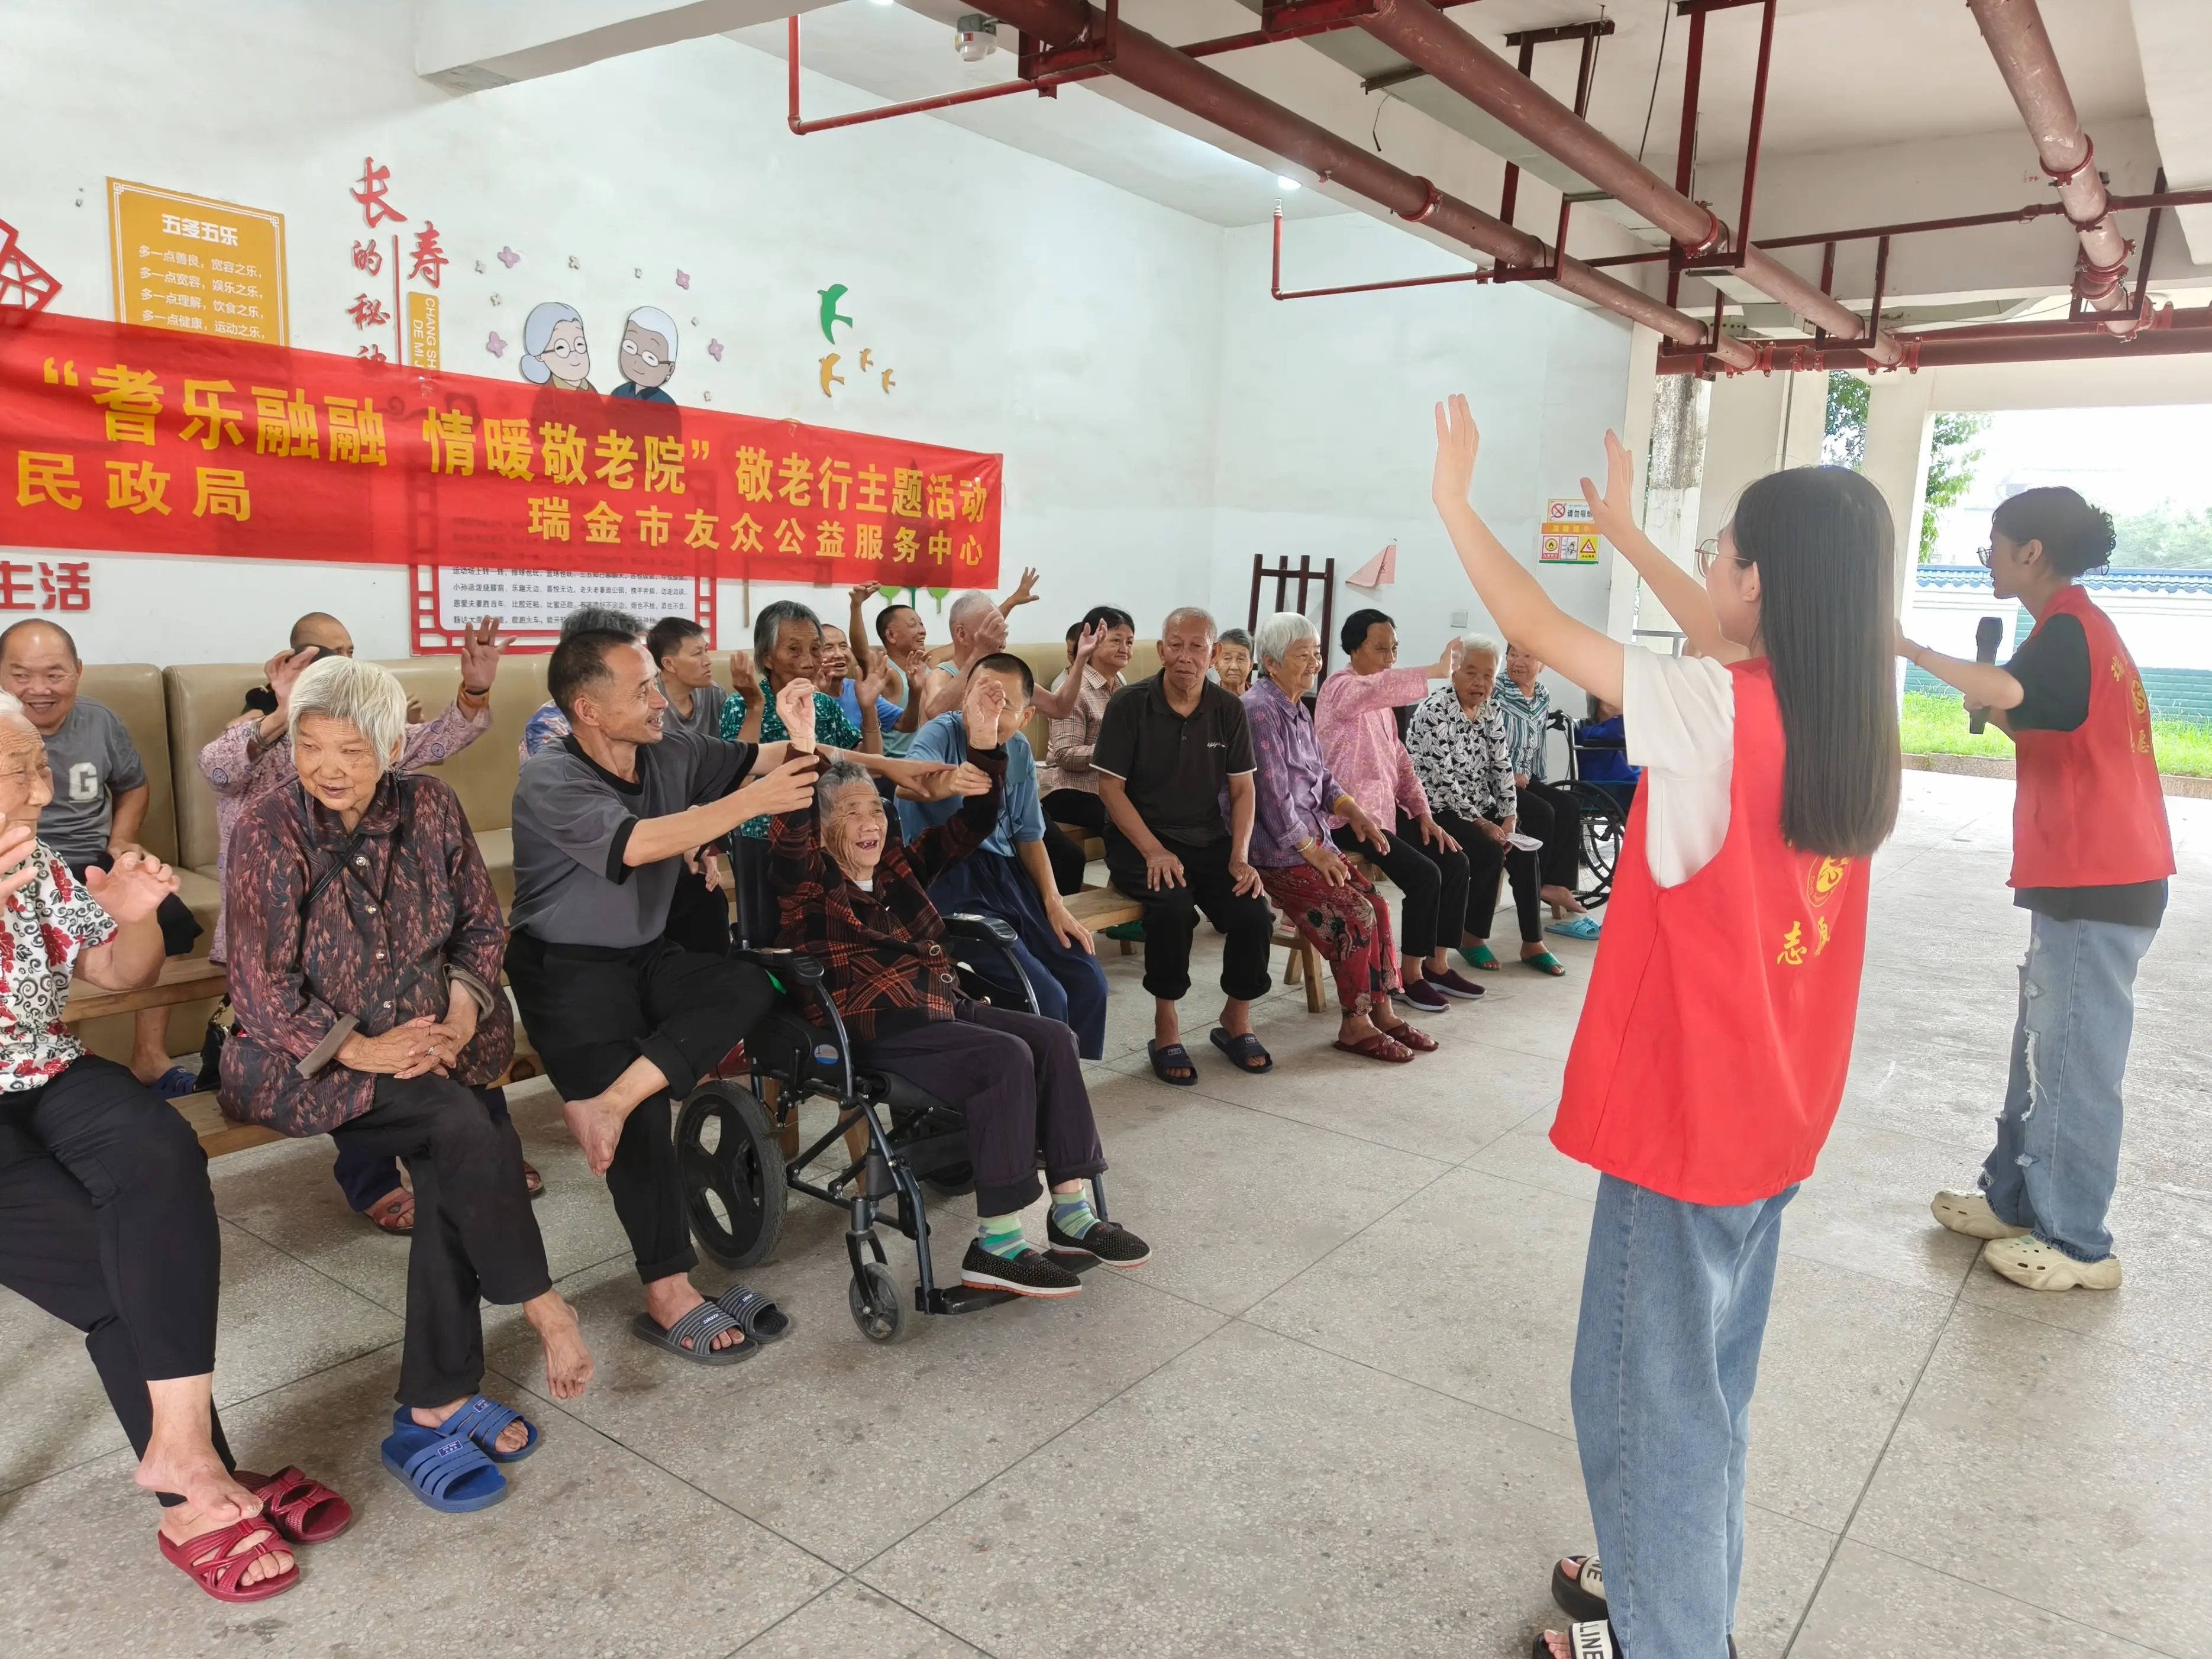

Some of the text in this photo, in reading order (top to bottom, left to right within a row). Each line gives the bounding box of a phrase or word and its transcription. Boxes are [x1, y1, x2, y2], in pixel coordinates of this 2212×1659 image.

[162, 214, 238, 246] 五多五乐
[414, 319, 424, 339] DE
[425, 298, 437, 370] CHANG SH
[414, 342, 424, 357] MI
[422, 406, 709, 494] 情暖敬老院”
[735, 446, 987, 523] 敬老行主题活动
[16, 450, 251, 521] 民政局
[527, 496, 983, 566] 瑞金市友众公益服务中心
[69, 762, 98, 800] G
